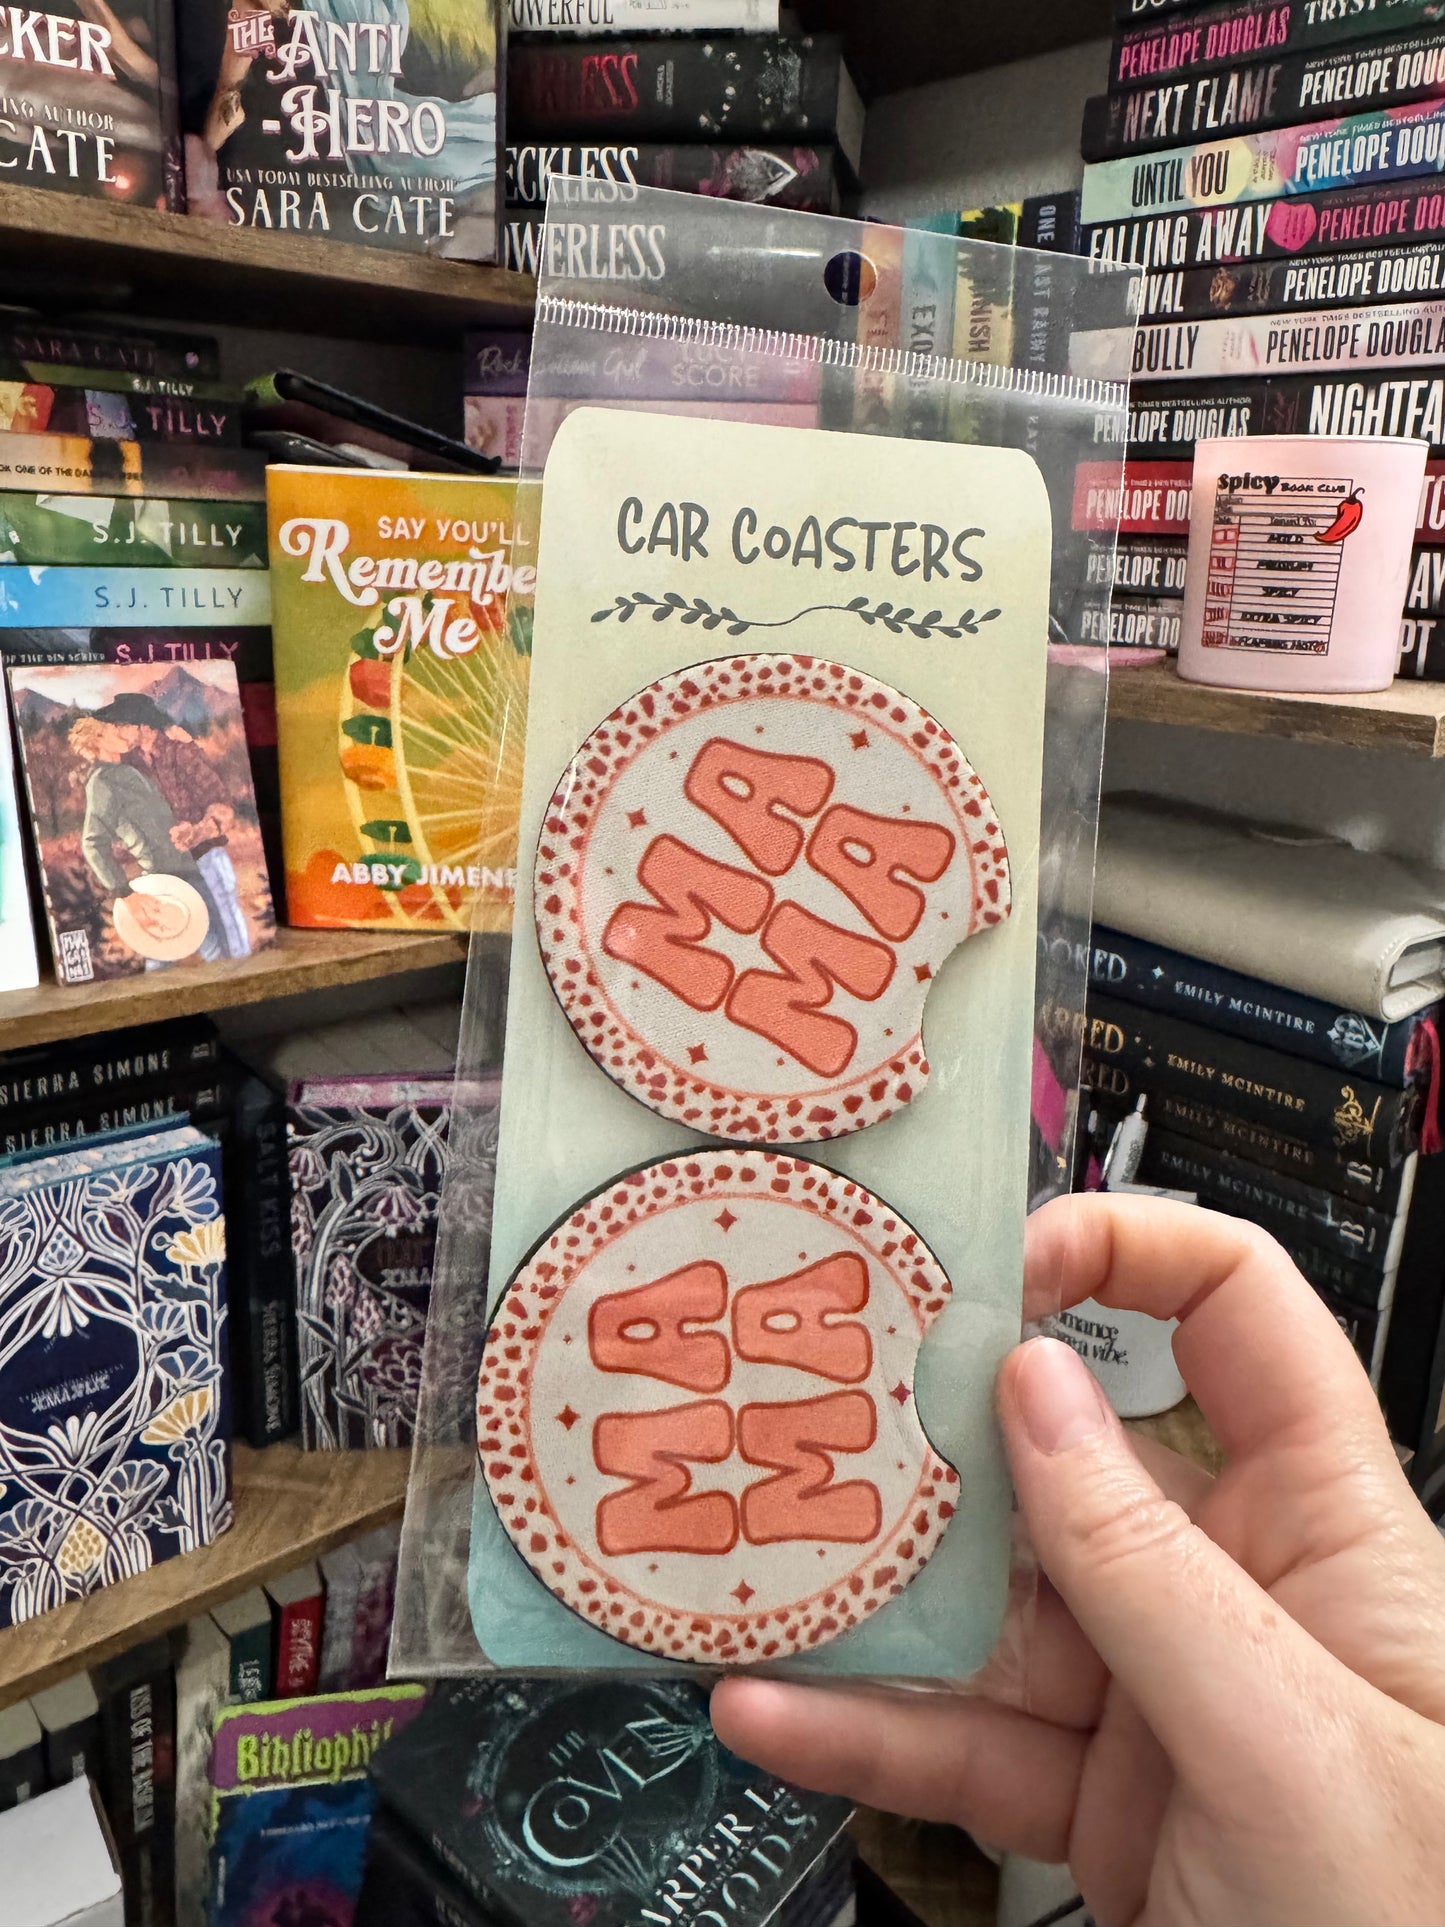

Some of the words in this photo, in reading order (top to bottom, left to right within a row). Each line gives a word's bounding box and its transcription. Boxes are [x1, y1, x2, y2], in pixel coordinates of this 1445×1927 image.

[0, 5, 117, 76] KER
[228, 14, 275, 53] THE
[267, 9, 403, 83] ANTI
[1117, 28, 1202, 81] PENELOPE
[1204, 6, 1290, 60] DOUGLAS
[1122, 83, 1190, 144] NEXT
[1191, 63, 1282, 132] FLAME
[1298, 57, 1393, 108] PENELOPE
[44, 103, 114, 132] AUTHOR
[1294, 131, 1393, 183] PENELOPE
[307, 172, 393, 190] BESTSELLING
[1131, 157, 1186, 209] UNTIL
[1190, 150, 1231, 198] YOU
[226, 187, 330, 230] SARA
[352, 194, 455, 237] CATE
[1036, 204, 1057, 244] ONE
[1317, 199, 1410, 243] PENELOPE
[504, 222, 666, 280] WERLESS
[1088, 215, 1190, 275] FALLING
[1195, 203, 1273, 261] AWAY
[1125, 271, 1184, 316] RIVAL
[1283, 260, 1376, 303] PENELOPE
[1377, 254, 1445, 295] DOUGL
[1131, 325, 1200, 374] BULLY
[1265, 324, 1362, 365] PENELOPE
[158, 380, 194, 396] TILLY
[671, 364, 761, 388] SCORE
[146, 405, 227, 436] TILLY
[1092, 409, 1170, 444] PENELOPE
[1172, 407, 1251, 443] DOUGLAS
[1309, 379, 1445, 444] NIGHTFA
[1085, 488, 1162, 521] PENELOPE
[160, 522, 242, 547] TILLY
[377, 515, 427, 541] SAY
[436, 519, 531, 546] YOU'LL
[617, 496, 710, 562] CAR
[1086, 553, 1162, 588] PENELOPE
[94, 585, 148, 609] S.J.
[160, 587, 243, 609] TILLY
[372, 596, 482, 661] Me
[1080, 610, 1156, 646] PENELOPE
[163, 641, 240, 662] TILLY
[330, 862, 408, 887] ABBY
[1174, 980, 1223, 1007] EMILY
[1228, 993, 1317, 1036] MCINTIRE
[0, 1070, 80, 1102] SIERRA
[93, 1050, 170, 1086] SIMONE
[1166, 1052, 1217, 1082] EMILY
[1221, 1072, 1307, 1114] MCINTIRE
[5, 1119, 87, 1154] SIERRA
